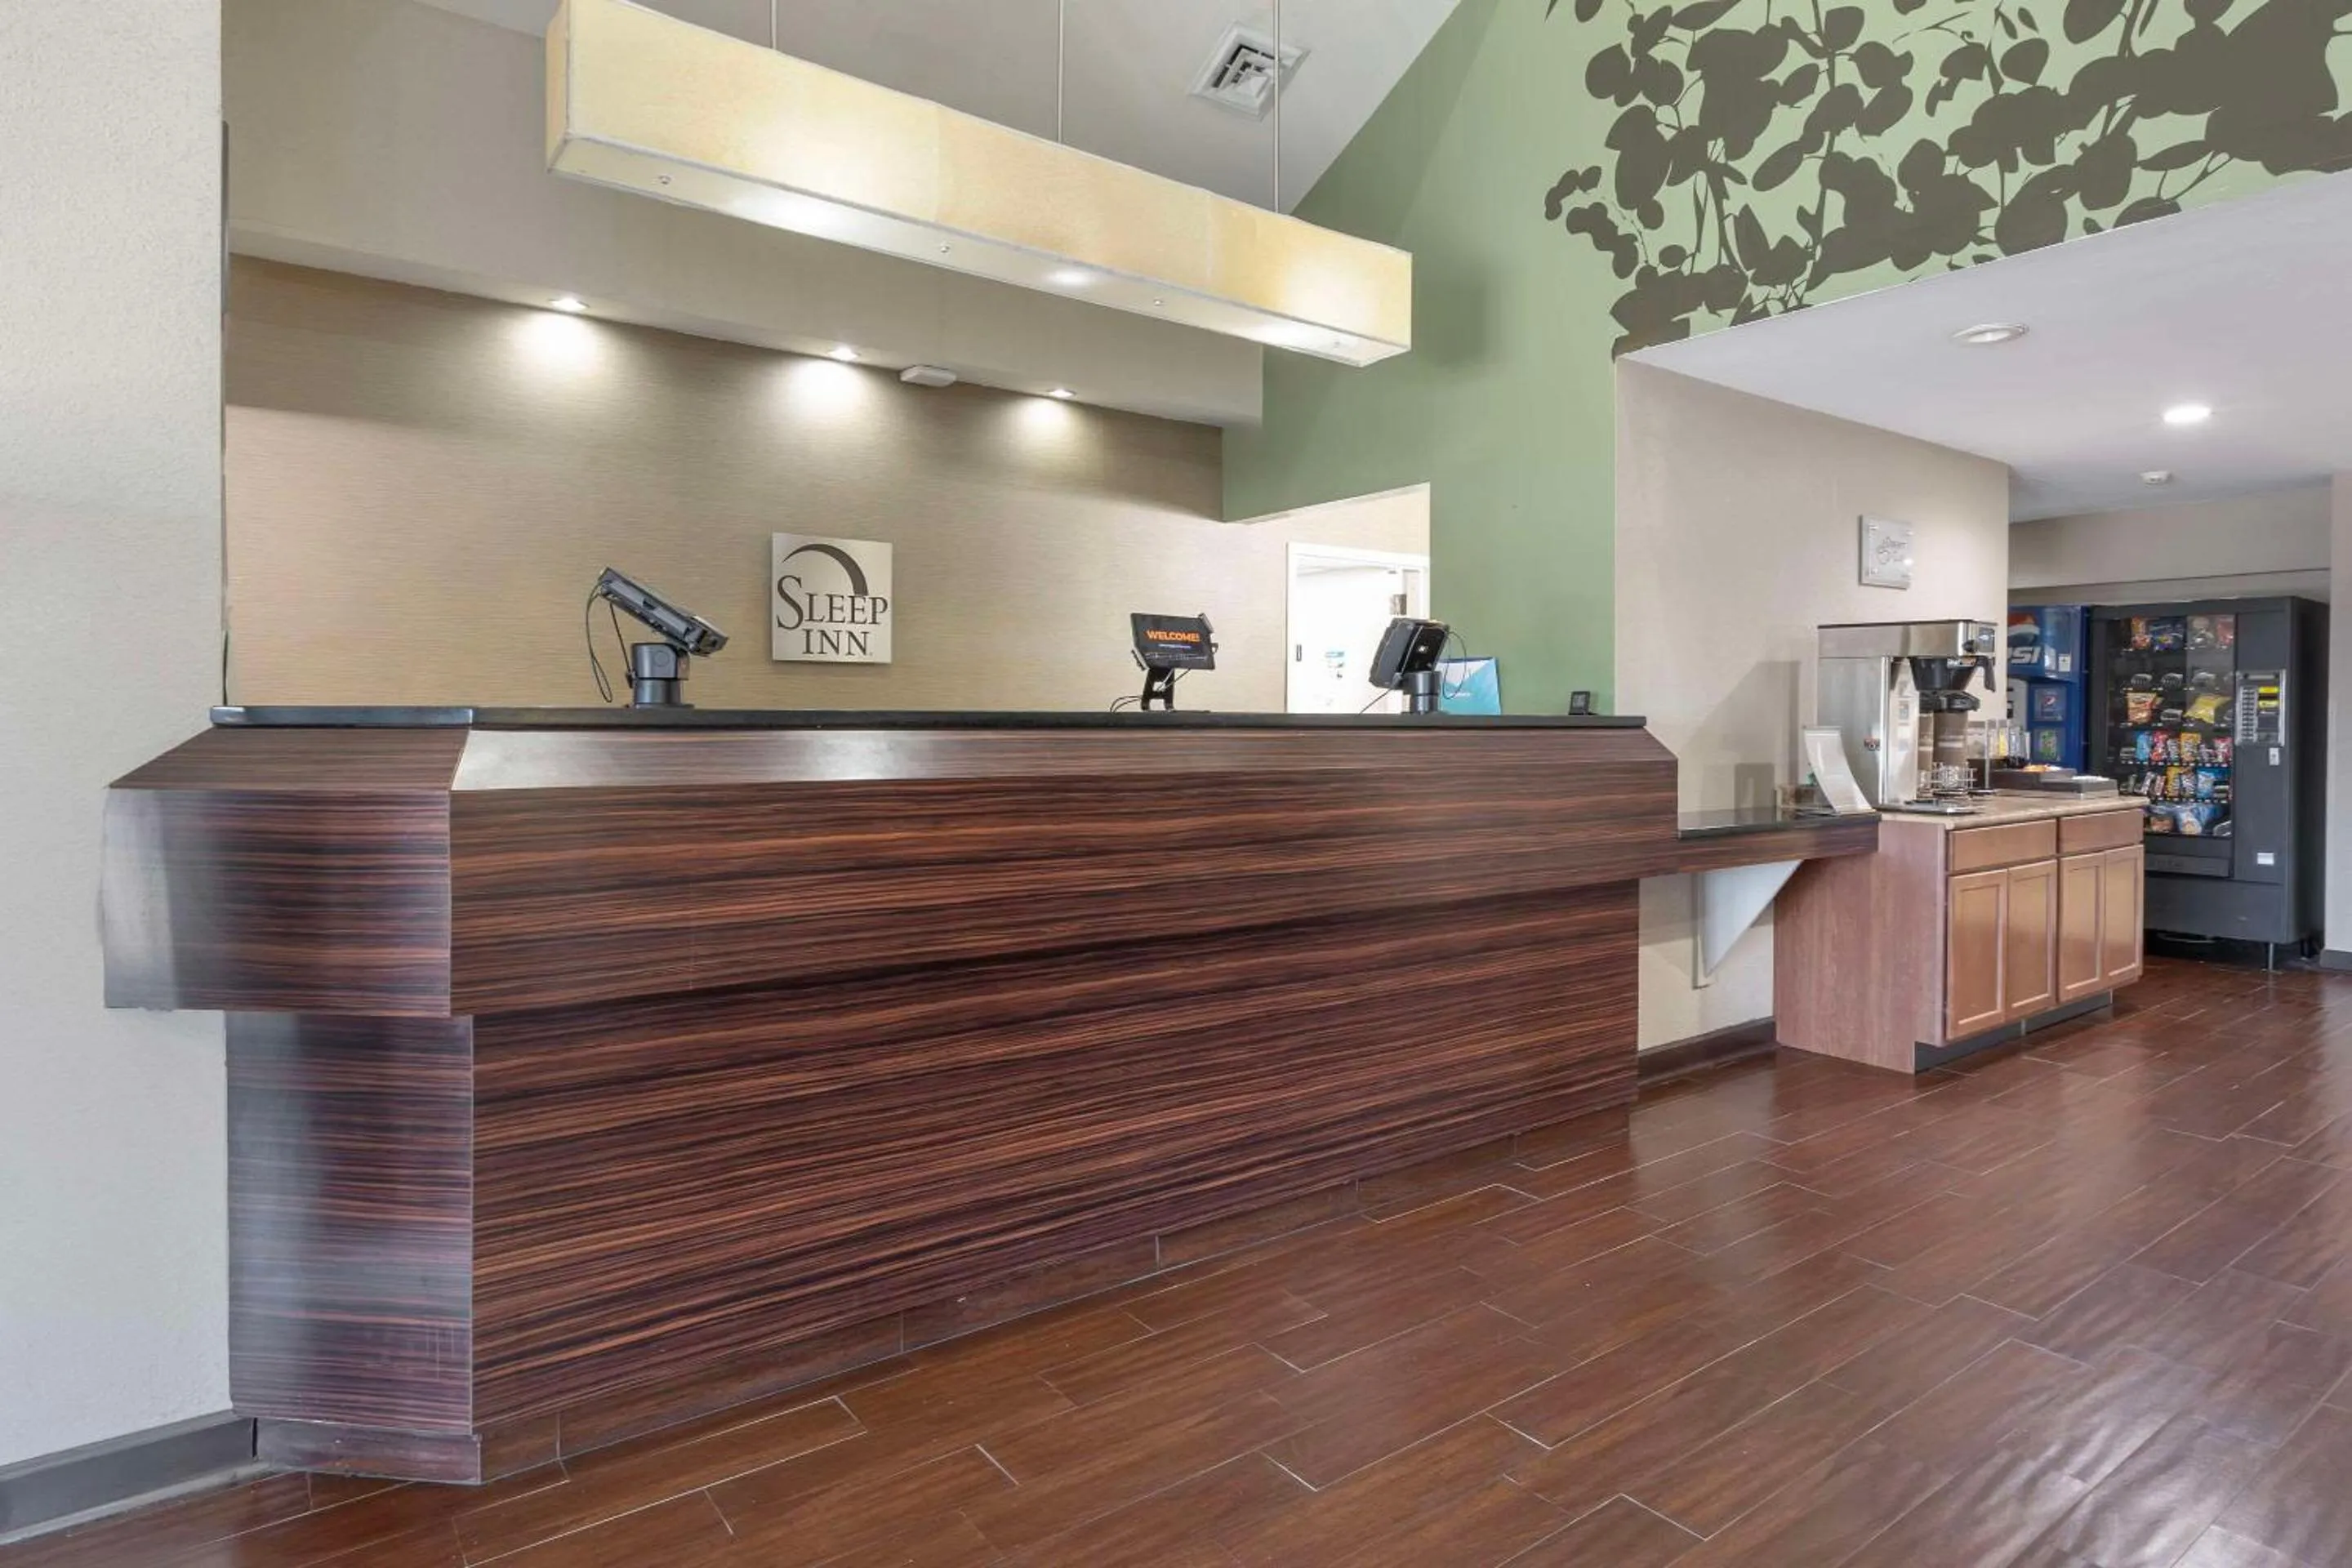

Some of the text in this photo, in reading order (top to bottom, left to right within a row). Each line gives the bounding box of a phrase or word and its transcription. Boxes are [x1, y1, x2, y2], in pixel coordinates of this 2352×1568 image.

[777, 575, 889, 630] SLEEP
[802, 628, 870, 656] INN
[1147, 630, 1200, 642] WELCOME!
